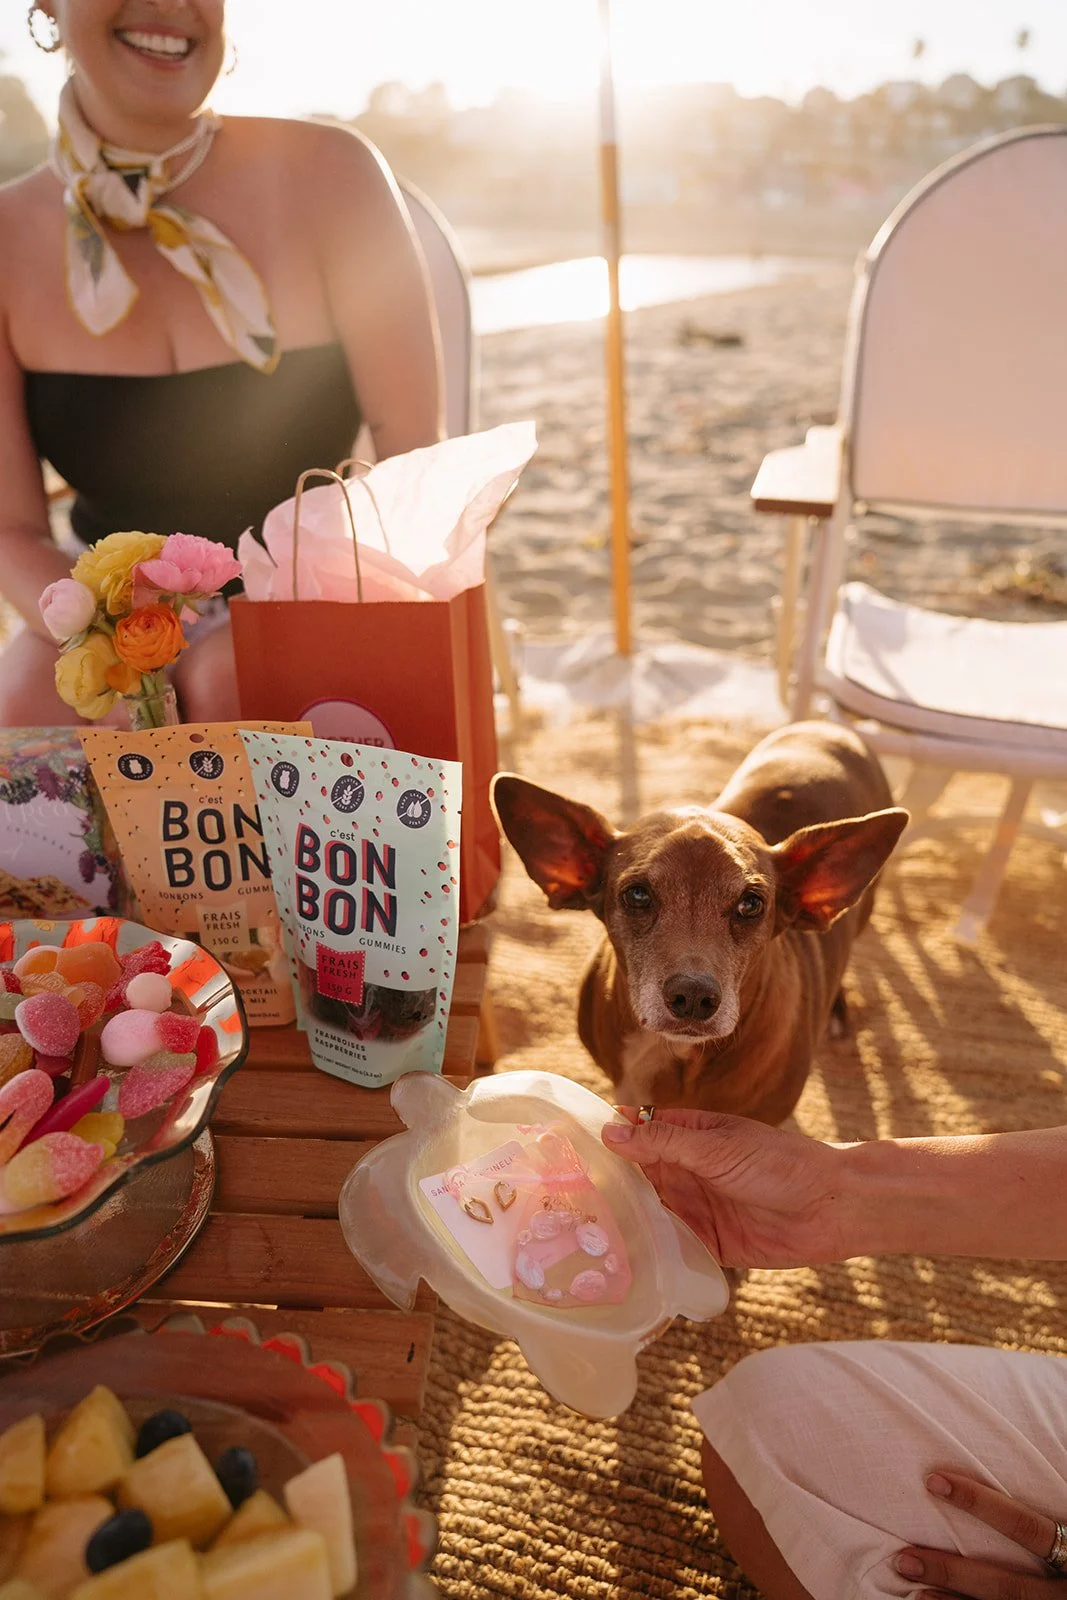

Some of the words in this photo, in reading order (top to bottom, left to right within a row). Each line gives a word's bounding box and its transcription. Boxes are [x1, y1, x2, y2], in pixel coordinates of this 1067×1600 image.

[198, 795, 223, 804] c'est
[163, 800, 264, 845] BON
[330, 829, 355, 841] c'est
[295, 822, 396, 889] BON
[164, 842, 271, 891] BON
[238, 884, 274, 895] GUMMI
[296, 872, 397, 937] BON
[203, 911, 241, 922] FRAIS
[206, 922, 240, 930] FRESH
[298, 923, 325, 938] BONS
[213, 937, 229, 945] 150
[232, 936, 239, 944] G
[359, 937, 406, 955] GUMMIES
[321, 955, 359, 970] FRAIS
[323, 966, 356, 978] FRESH
[327, 983, 343, 993] 150
[345, 986, 352, 995] G
[315, 1028, 366, 1052] FRAMBOISES
[315, 1037, 367, 1061] RASPBERRIES
